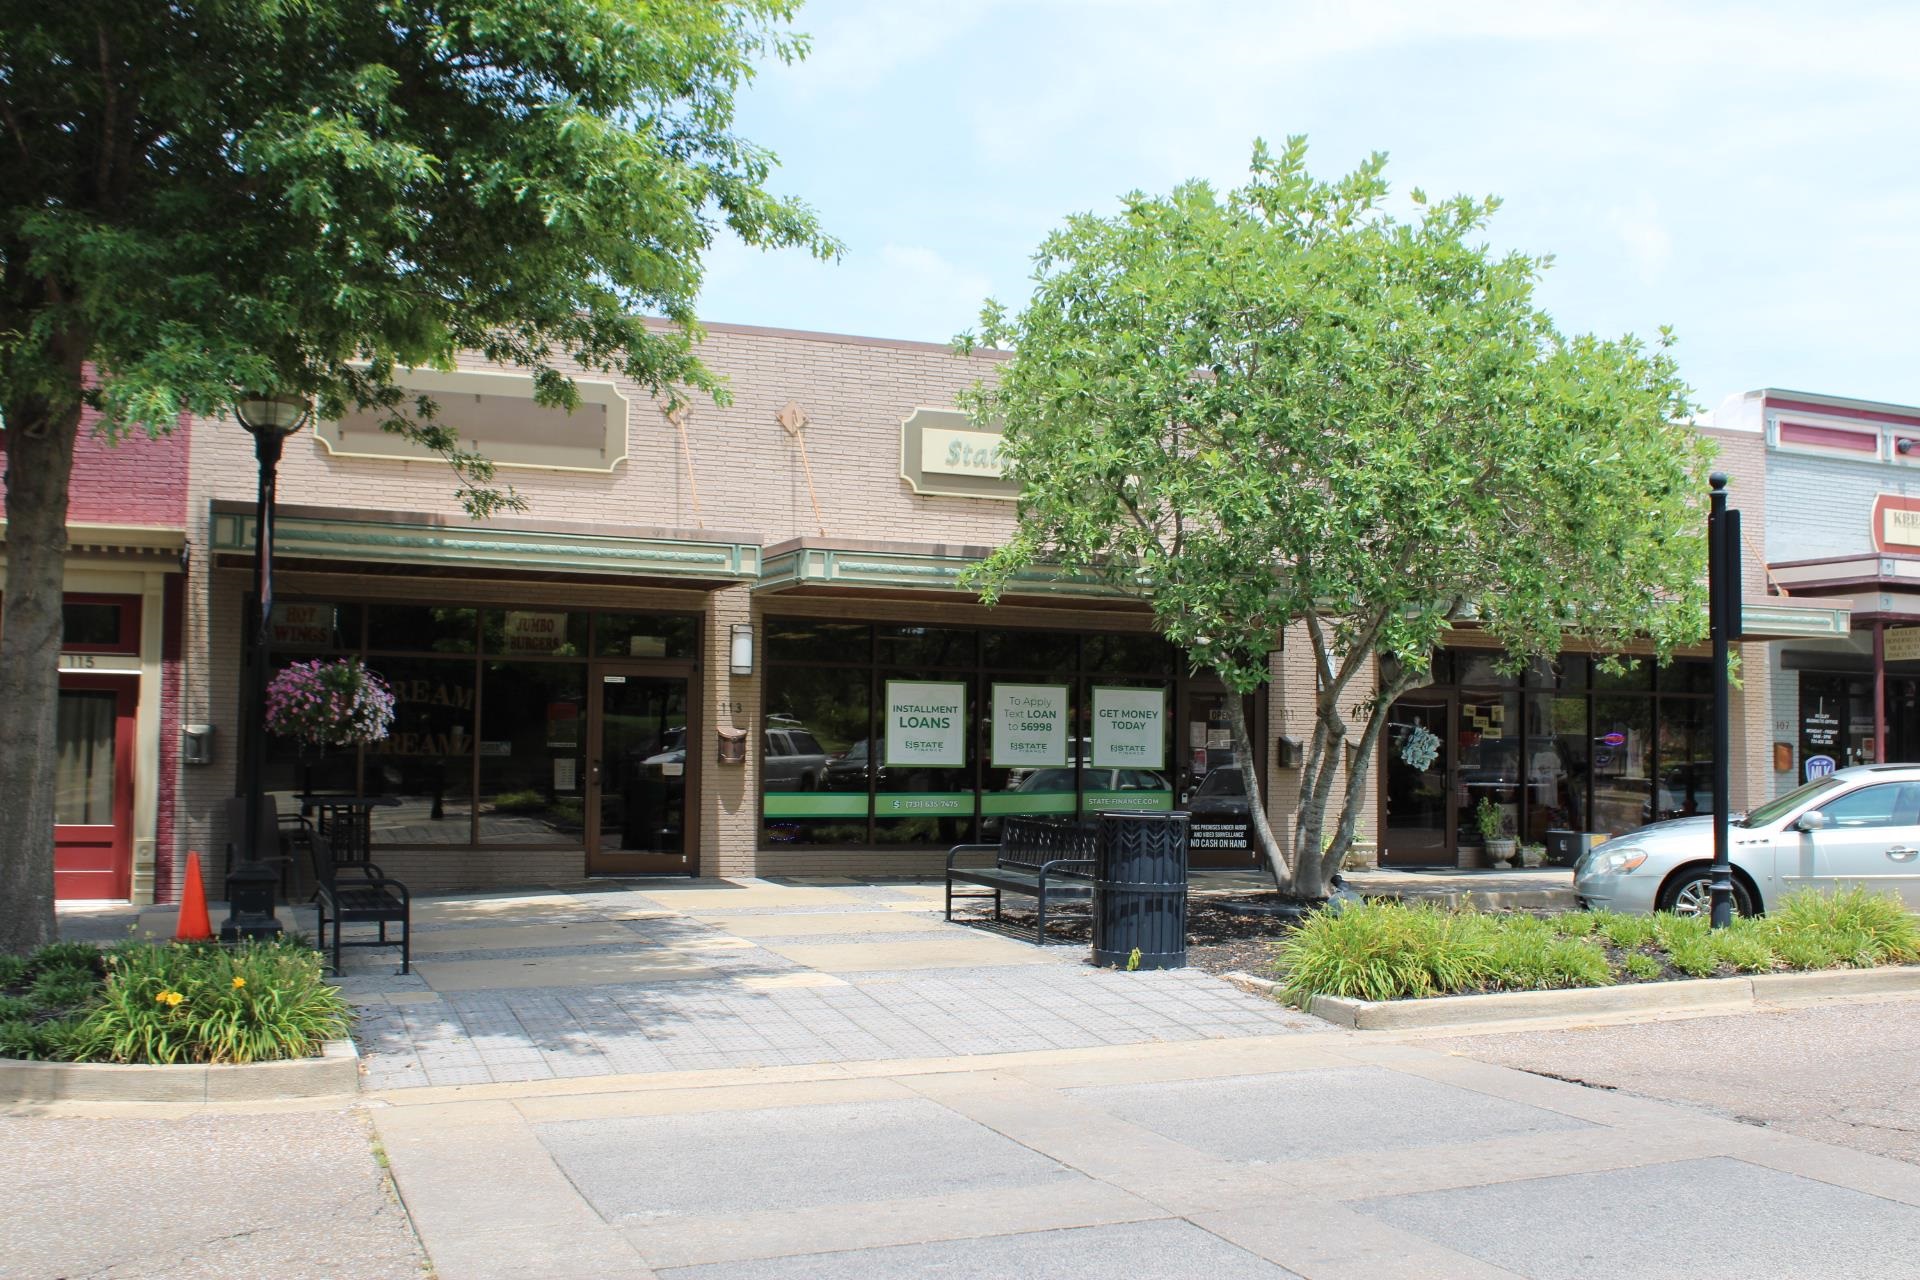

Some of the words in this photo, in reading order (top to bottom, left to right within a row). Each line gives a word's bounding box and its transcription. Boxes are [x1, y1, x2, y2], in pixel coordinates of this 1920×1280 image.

[1893, 511, 1920, 529] KEE
[288, 607, 316, 623] HOT
[516, 618, 554, 632] JUMBO
[274, 625, 327, 642] WINGS
[510, 636, 560, 649] BURGERS
[70, 655, 94, 669] 115
[392, 679, 475, 711] REAM
[722, 702, 742, 714] 113
[1009, 696, 1021, 706] To
[1023, 697, 1052, 708] Apply
[893, 704, 959, 714] INSTALLMENT
[1004, 709, 1024, 718] Text
[1027, 710, 1057, 719] LOAN
[1099, 709, 1119, 718] GET
[1121, 710, 1159, 719] MONEY
[1212, 711, 1232, 720] OPEN
[899, 716, 950, 728] LOANS
[1008, 723, 1019, 731] to
[1020, 722, 1053, 732] 56998
[1111, 721, 1146, 730] TODAY
[1775, 720, 1791, 730] 107
[913, 741, 944, 749] STATE
[1190, 838, 1200, 847] NO
[1200, 839, 1218, 847] CASH
[1219, 839, 1229, 848] ON
[1229, 839, 1247, 848] HAND
